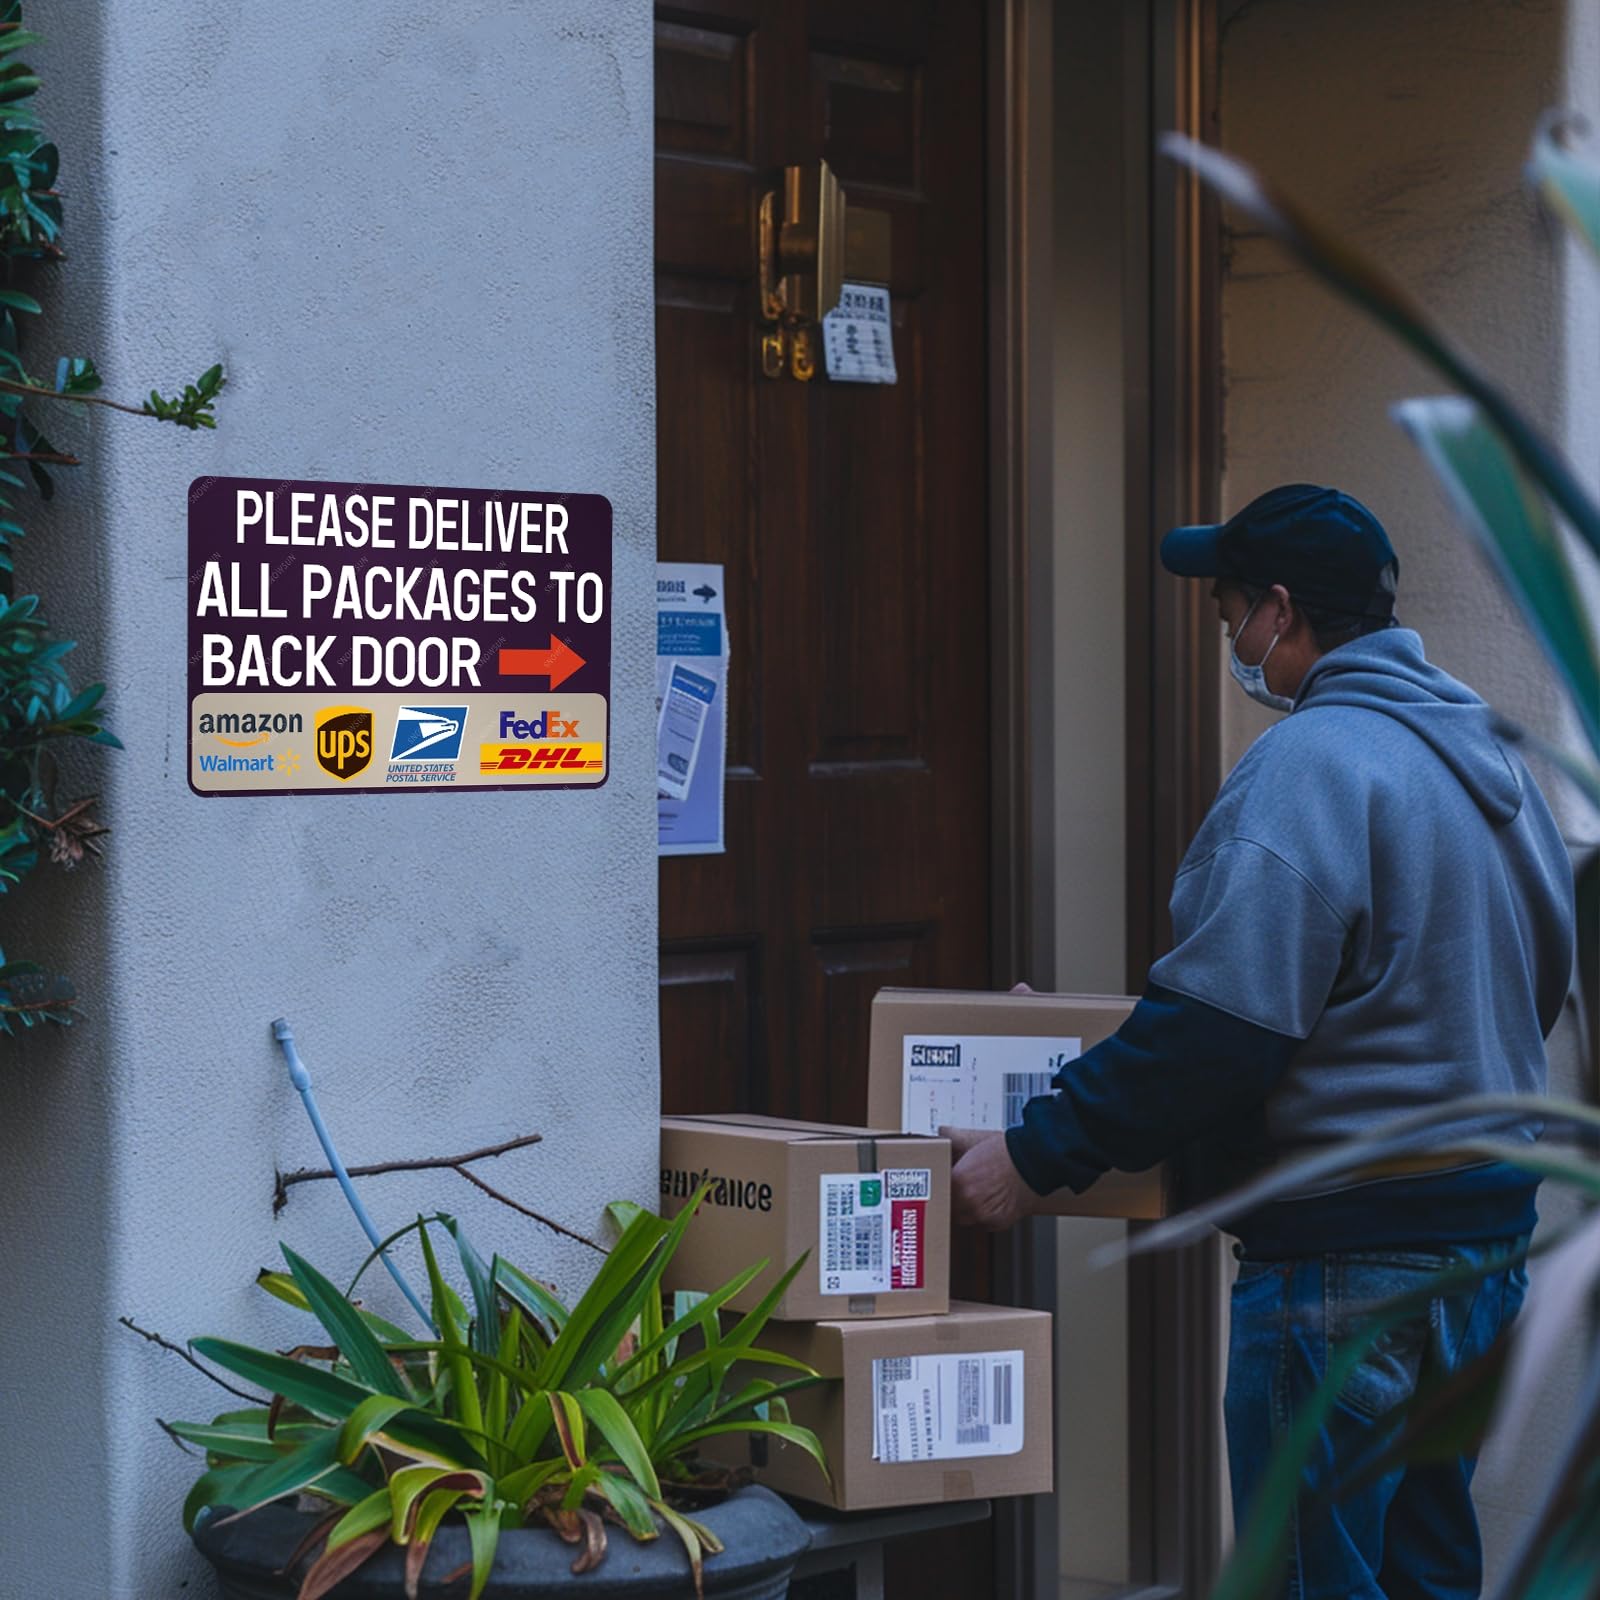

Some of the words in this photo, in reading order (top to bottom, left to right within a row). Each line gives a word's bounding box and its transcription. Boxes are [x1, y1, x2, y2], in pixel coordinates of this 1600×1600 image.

[236, 490, 396, 549] PLEASE
[408, 497, 569, 555] DELIVER
[196, 560, 288, 618] ALL
[302, 563, 537, 623] PACKAGES
[549, 571, 603, 624] TO
[202, 633, 337, 687] BACK
[352, 635, 482, 688] DOOR
[199, 713, 303, 734] amazon
[499, 710, 580, 739] FedEx
[319, 730, 370, 770] ups
[497, 747, 587, 769] DHL
[199, 755, 275, 773] Walmart
[388, 764, 423, 773] UNITED
[423, 764, 455, 772] STATES
[386, 774, 419, 783] POSTAL
[420, 774, 456, 782] SERVICE
